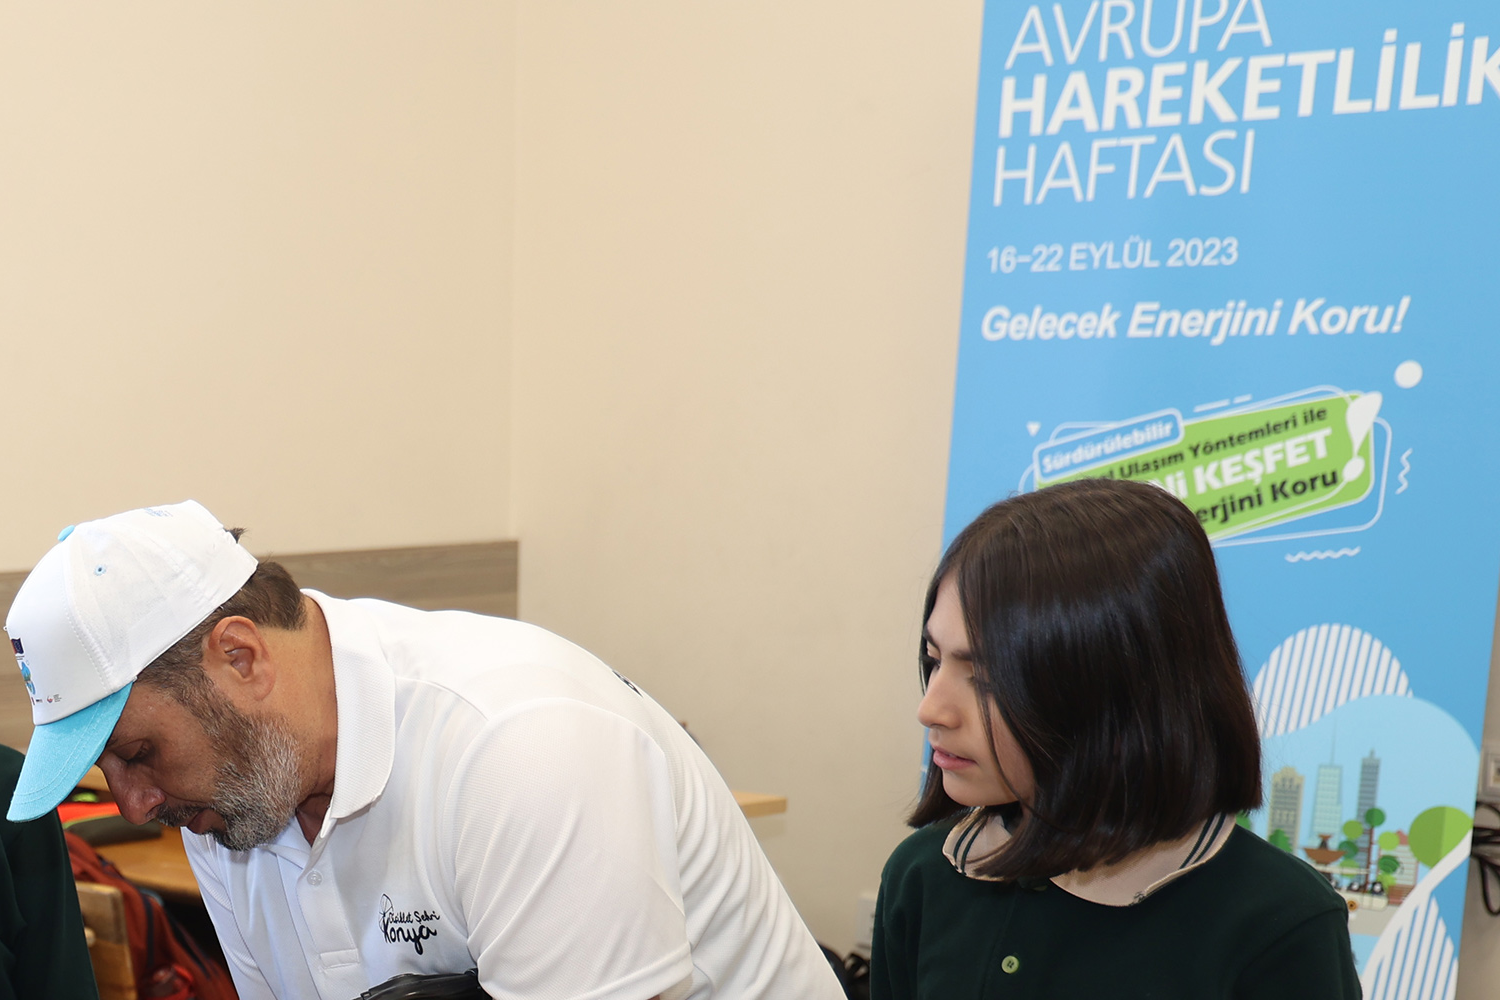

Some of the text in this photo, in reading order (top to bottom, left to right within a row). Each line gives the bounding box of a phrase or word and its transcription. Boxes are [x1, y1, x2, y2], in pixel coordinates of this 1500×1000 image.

[1005, 0, 1273, 70] AVRUPA
[999, 22, 1500, 138] HAREKETLİLİK
[993, 129, 1256, 207] HAFTASI
[1069, 235, 1160, 271] EYLÜL
[1166, 236, 1240, 267] 2023
[981, 296, 1411, 346] Gelecek Enerjini Koru!
[1042, 420, 1174, 473] Sürdürülebilir
[1120, 452, 1185, 479] Ulaşım
[1189, 415, 1299, 459] Yöntemleri
[1303, 407, 1328, 425] ile
[1193, 426, 1332, 495] KEŞFET
[1196, 470, 1338, 524] erjini Koru
[382, 918, 438, 956] Konya
